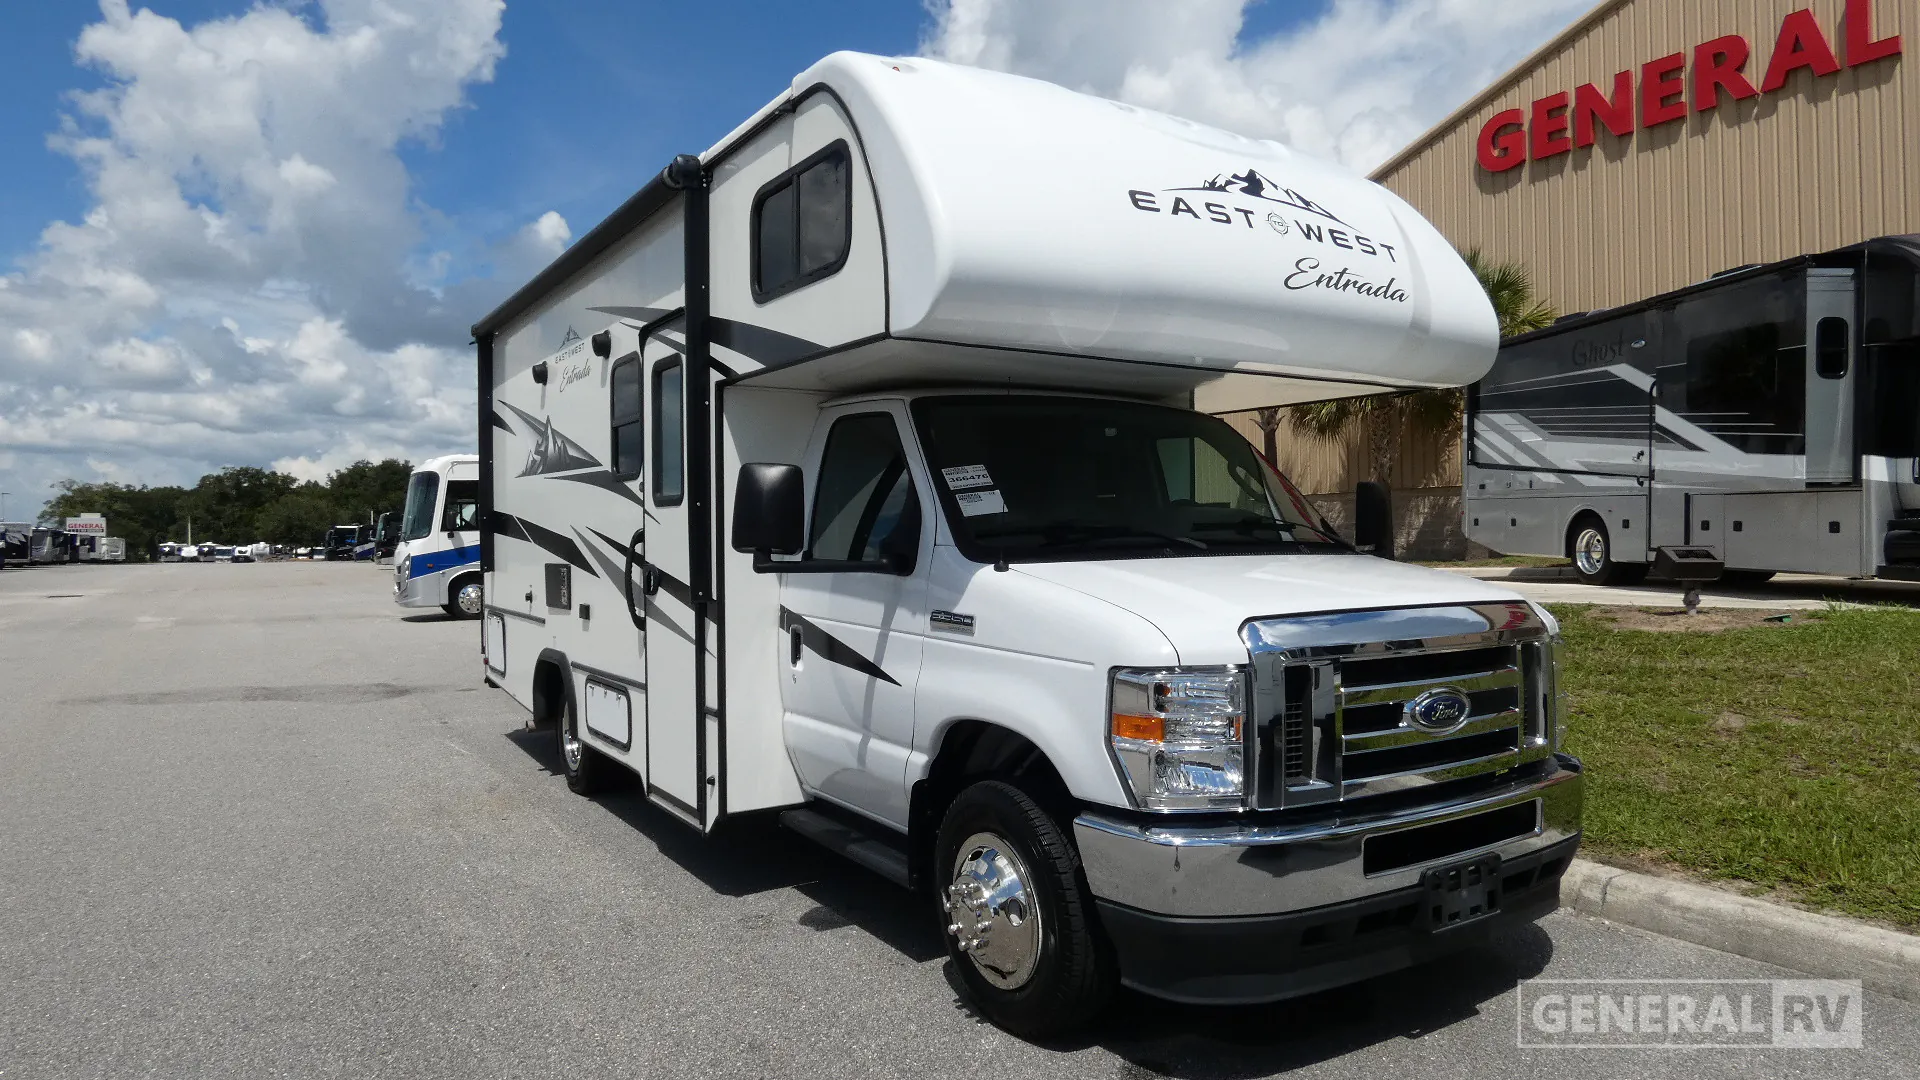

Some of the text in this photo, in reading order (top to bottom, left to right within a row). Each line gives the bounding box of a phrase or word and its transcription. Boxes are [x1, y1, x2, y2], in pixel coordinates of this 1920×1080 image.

[1477, 0, 1902, 172] GENERAL
[1128, 189, 1255, 229] EAST
[1294, 219, 1397, 263] WEST
[1283, 257, 1410, 303] Entrada
[1572, 329, 1624, 366] Ghost
[560, 358, 592, 392] Entrada
[1431, 700, 1459, 721] Ford
